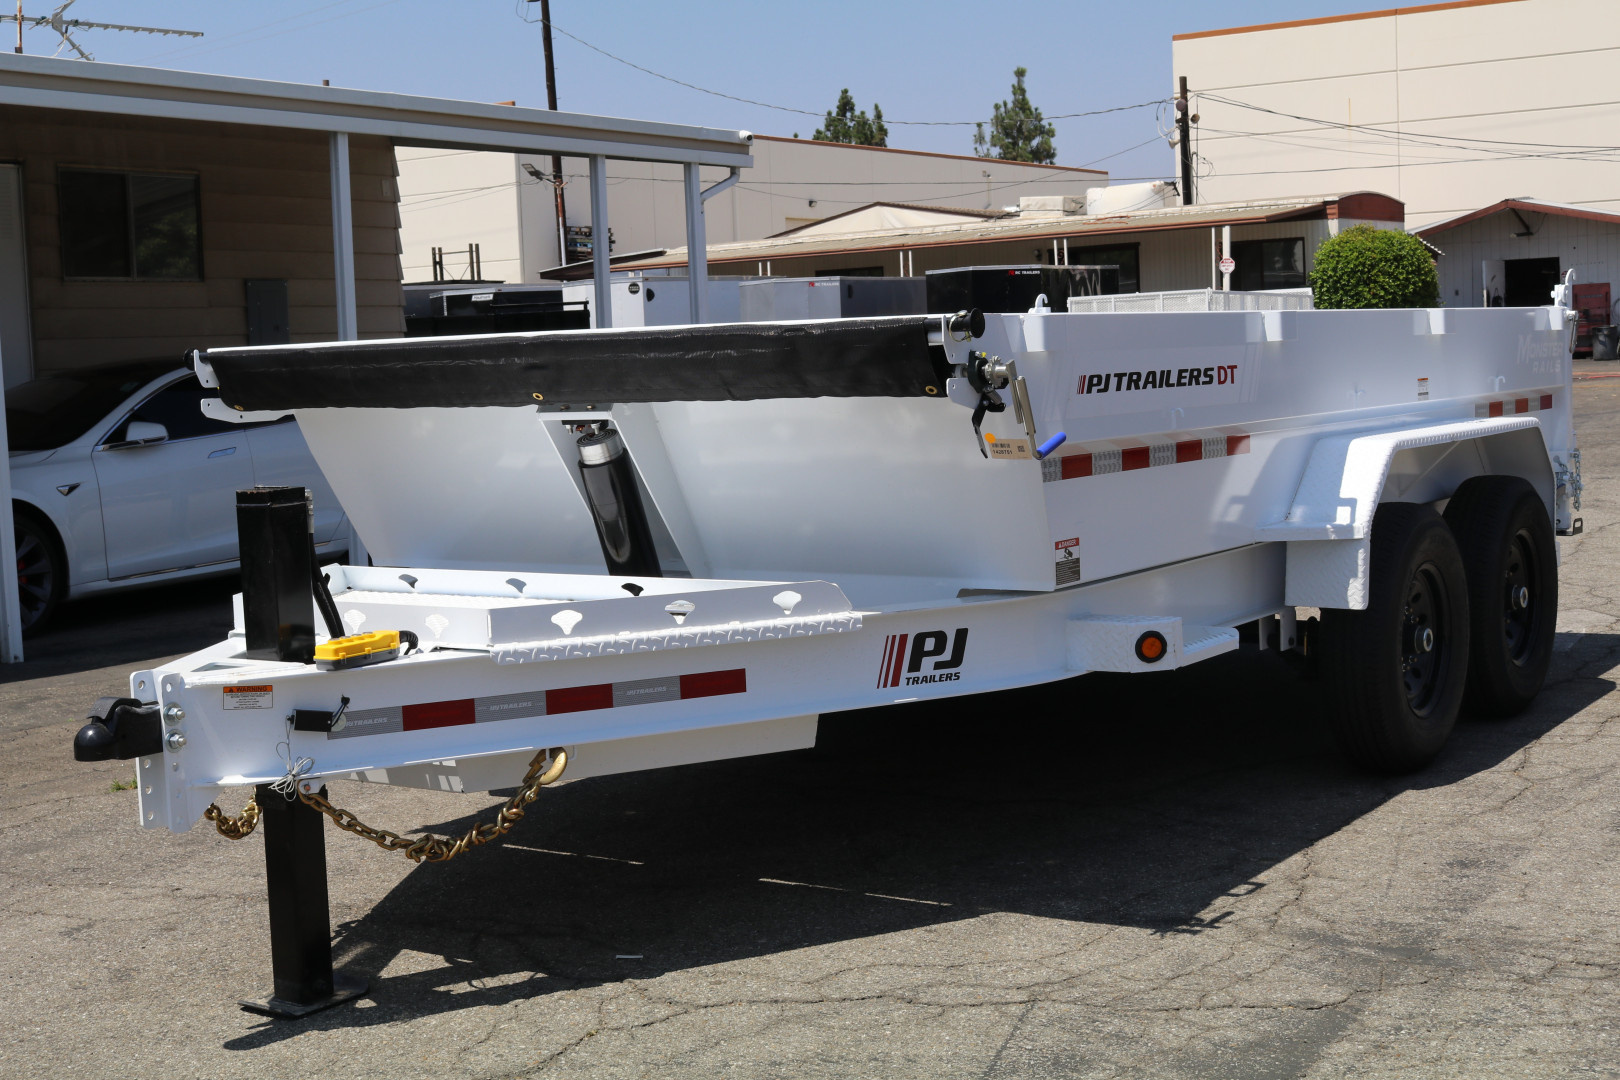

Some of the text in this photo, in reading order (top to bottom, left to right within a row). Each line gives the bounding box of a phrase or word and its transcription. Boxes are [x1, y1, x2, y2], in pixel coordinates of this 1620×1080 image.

[1217, 365, 1238, 385] DT
[1533, 360, 1560, 374] RAILS
[907, 628, 968, 673] PJ
[905, 672, 960, 686] TRAILERS
